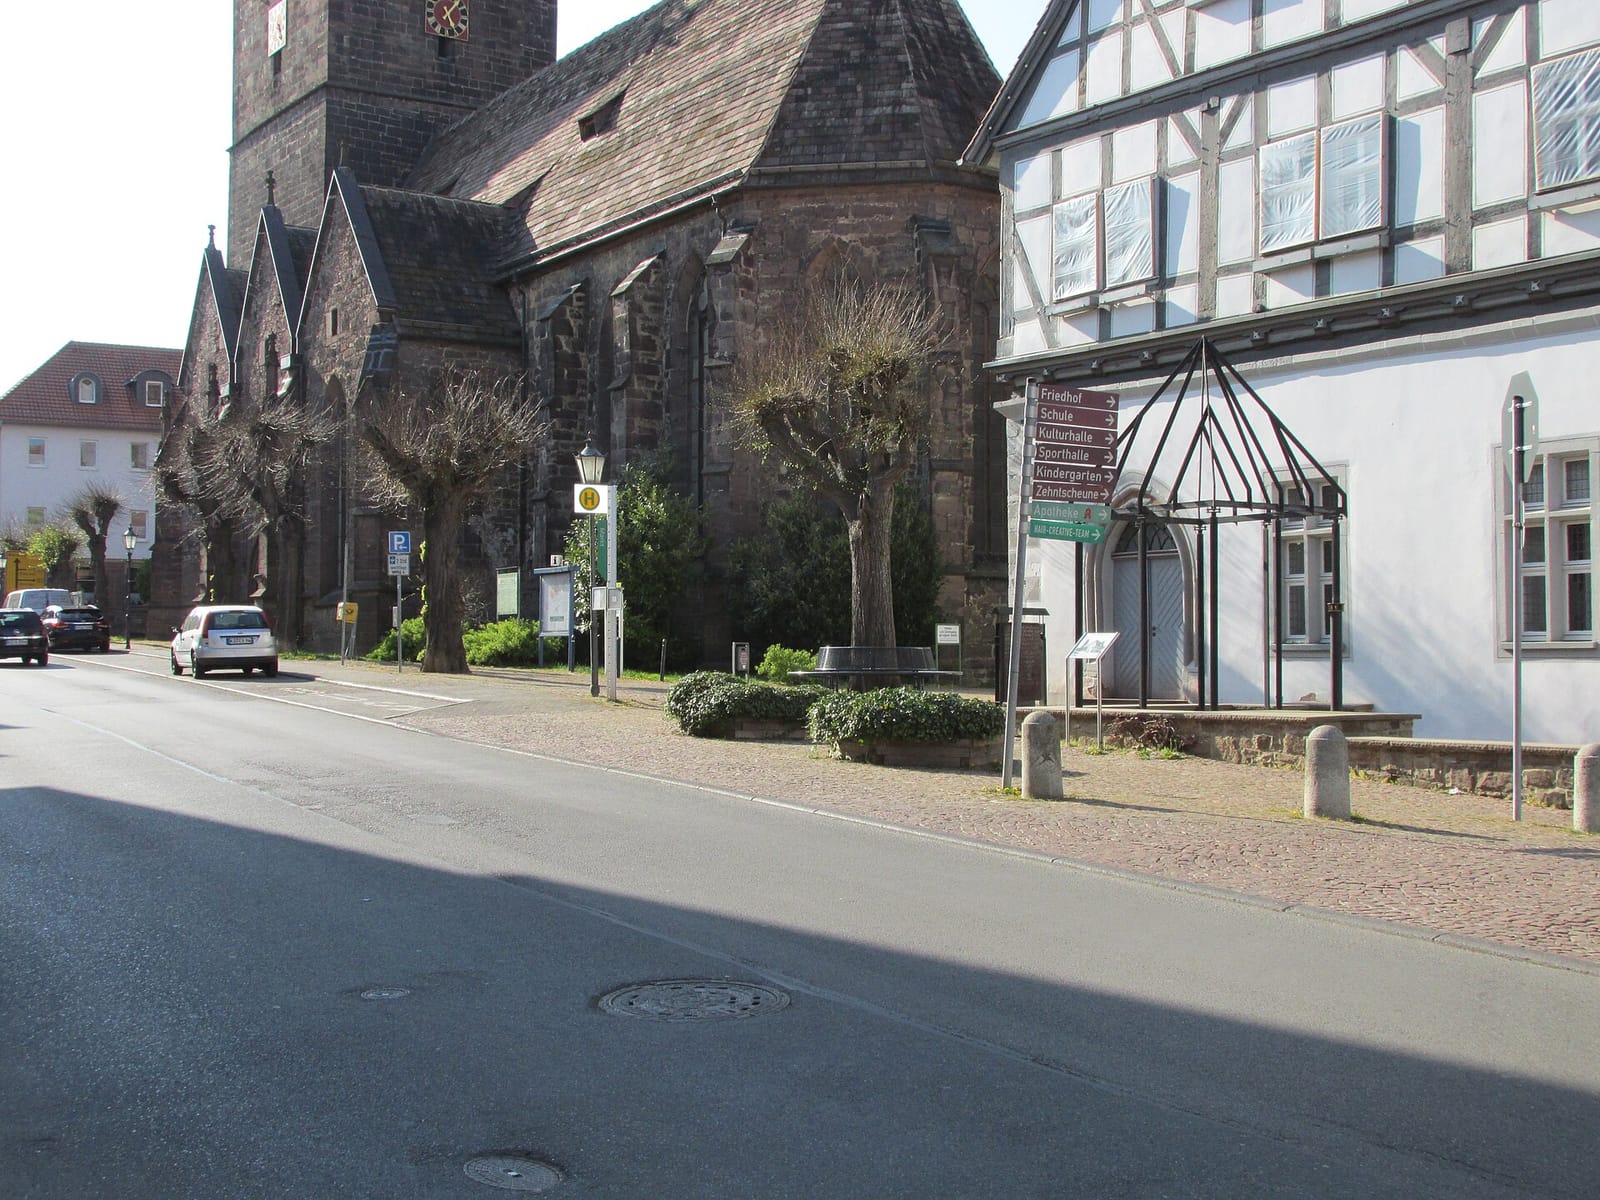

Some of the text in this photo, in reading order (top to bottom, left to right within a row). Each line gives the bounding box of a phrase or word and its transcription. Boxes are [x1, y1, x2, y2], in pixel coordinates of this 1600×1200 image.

[1041, 388, 1082, 403] Friedhof
[1040, 407, 1073, 421] Schule
[1038, 427, 1093, 443] Kulturhalle
[1038, 446, 1089, 462] Sporthalle
[1036, 465, 1102, 482] Kindergarten
[583, 491, 596, 506] H
[1035, 485, 1099, 500] Zehntscheune
[1034, 504, 1079, 518] Apotheke
[394, 534, 405, 550] P
